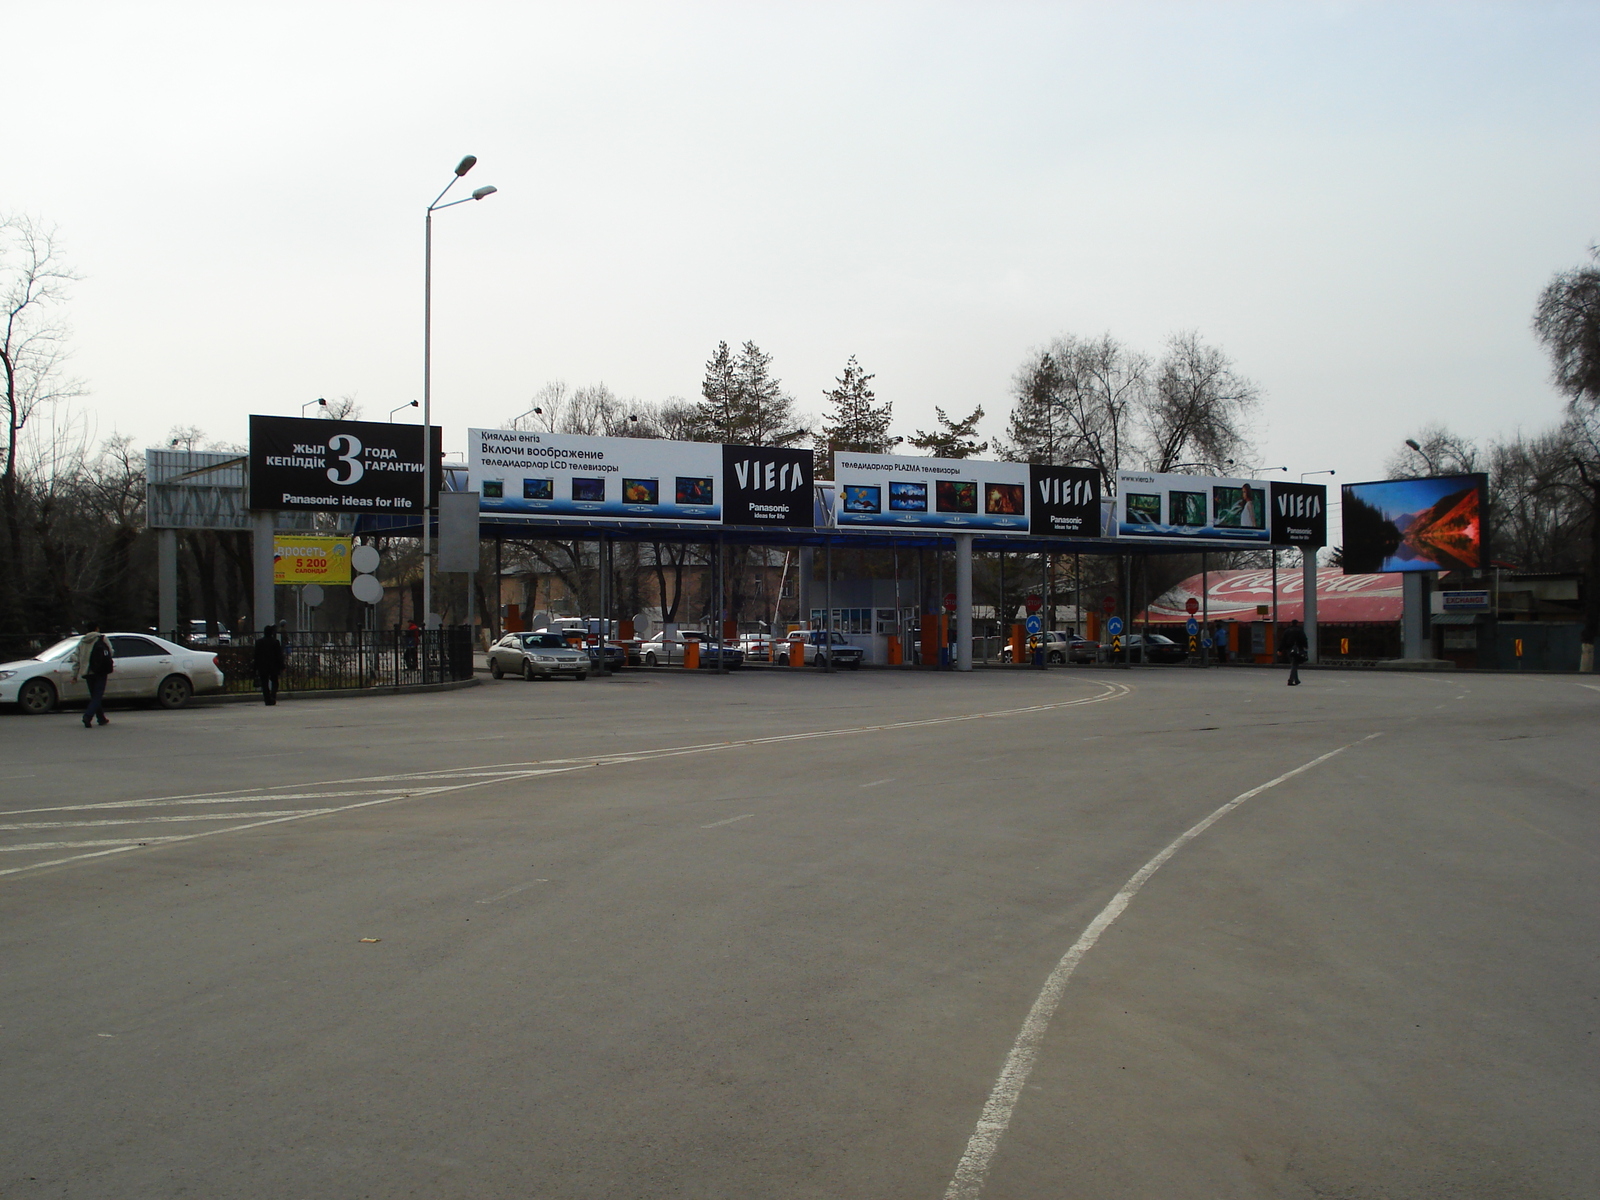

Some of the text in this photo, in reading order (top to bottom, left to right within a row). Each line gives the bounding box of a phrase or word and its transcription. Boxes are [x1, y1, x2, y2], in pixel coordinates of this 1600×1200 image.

[481, 431, 541, 443] Қиялды енгіз
[293, 443, 325, 455] ЖЫЛ
[365, 447, 398, 459] ГОДА
[481, 443, 604, 460] Включи воображение
[327, 434, 364, 485] 3
[481, 457, 619, 473] теледидарлар LCD телевизоры
[841, 461, 960, 475] теледидарлар PLAZMA телевизоры
[282, 493, 412, 508] Panasonic ideas for life
[748, 502, 790, 512] Panasonic
[1050, 515, 1083, 524] Panasonic
[1287, 526, 1312, 535] Panasonic
[275, 544, 326, 559] вросеть
[296, 558, 327, 568] 5 200
[945, 598, 957, 606] STO
